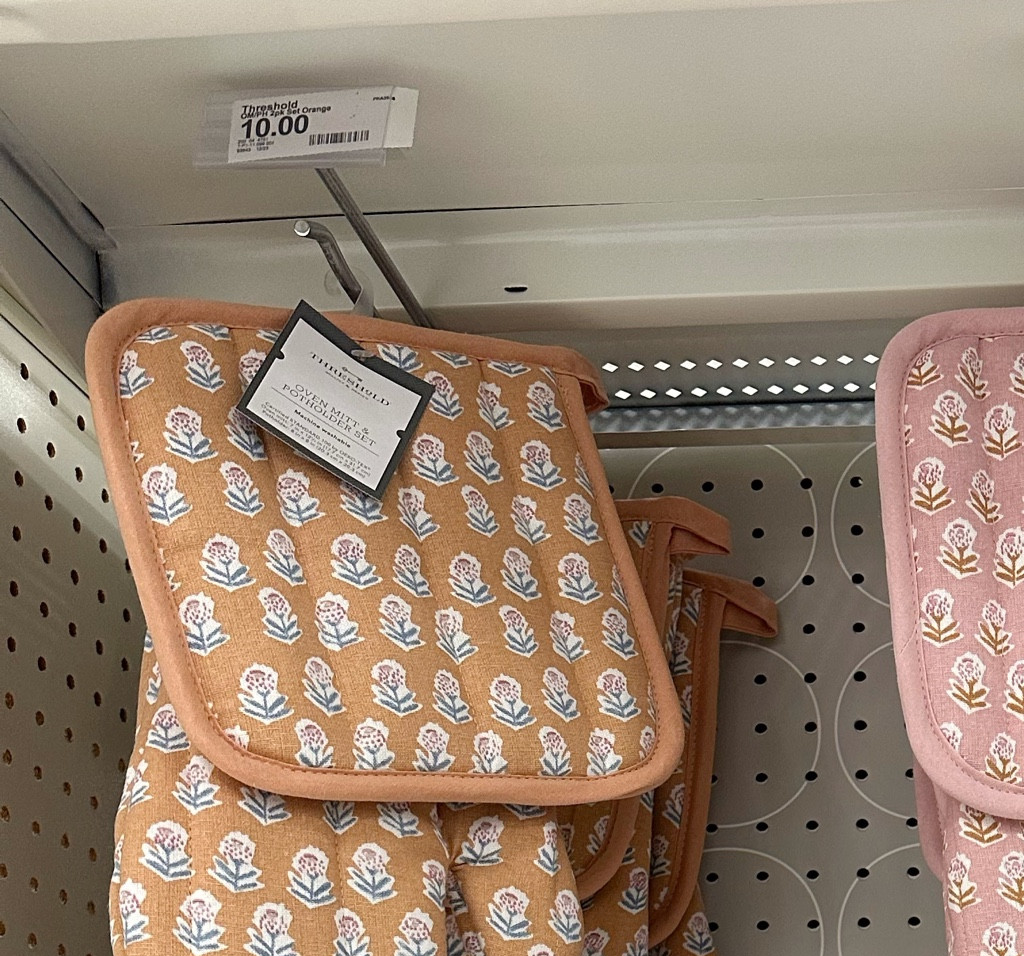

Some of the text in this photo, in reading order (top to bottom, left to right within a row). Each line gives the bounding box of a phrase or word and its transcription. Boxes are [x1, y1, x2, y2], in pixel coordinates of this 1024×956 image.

[241, 111, 268, 119] OM/PH
[302, 106, 331, 115] Orange
[241, 114, 309, 139] 10.00
[242, 100, 298, 114] Threshold
[311, 352, 389, 406] THRESHOLD
[282, 384, 352, 432] POTHOLDER
[354, 431, 376, 446] SET
[294, 409, 351, 448] Machine washable
[295, 384, 328, 408] OVEN
[330, 407, 359, 427] MITT
[362, 427, 369, 435] &
